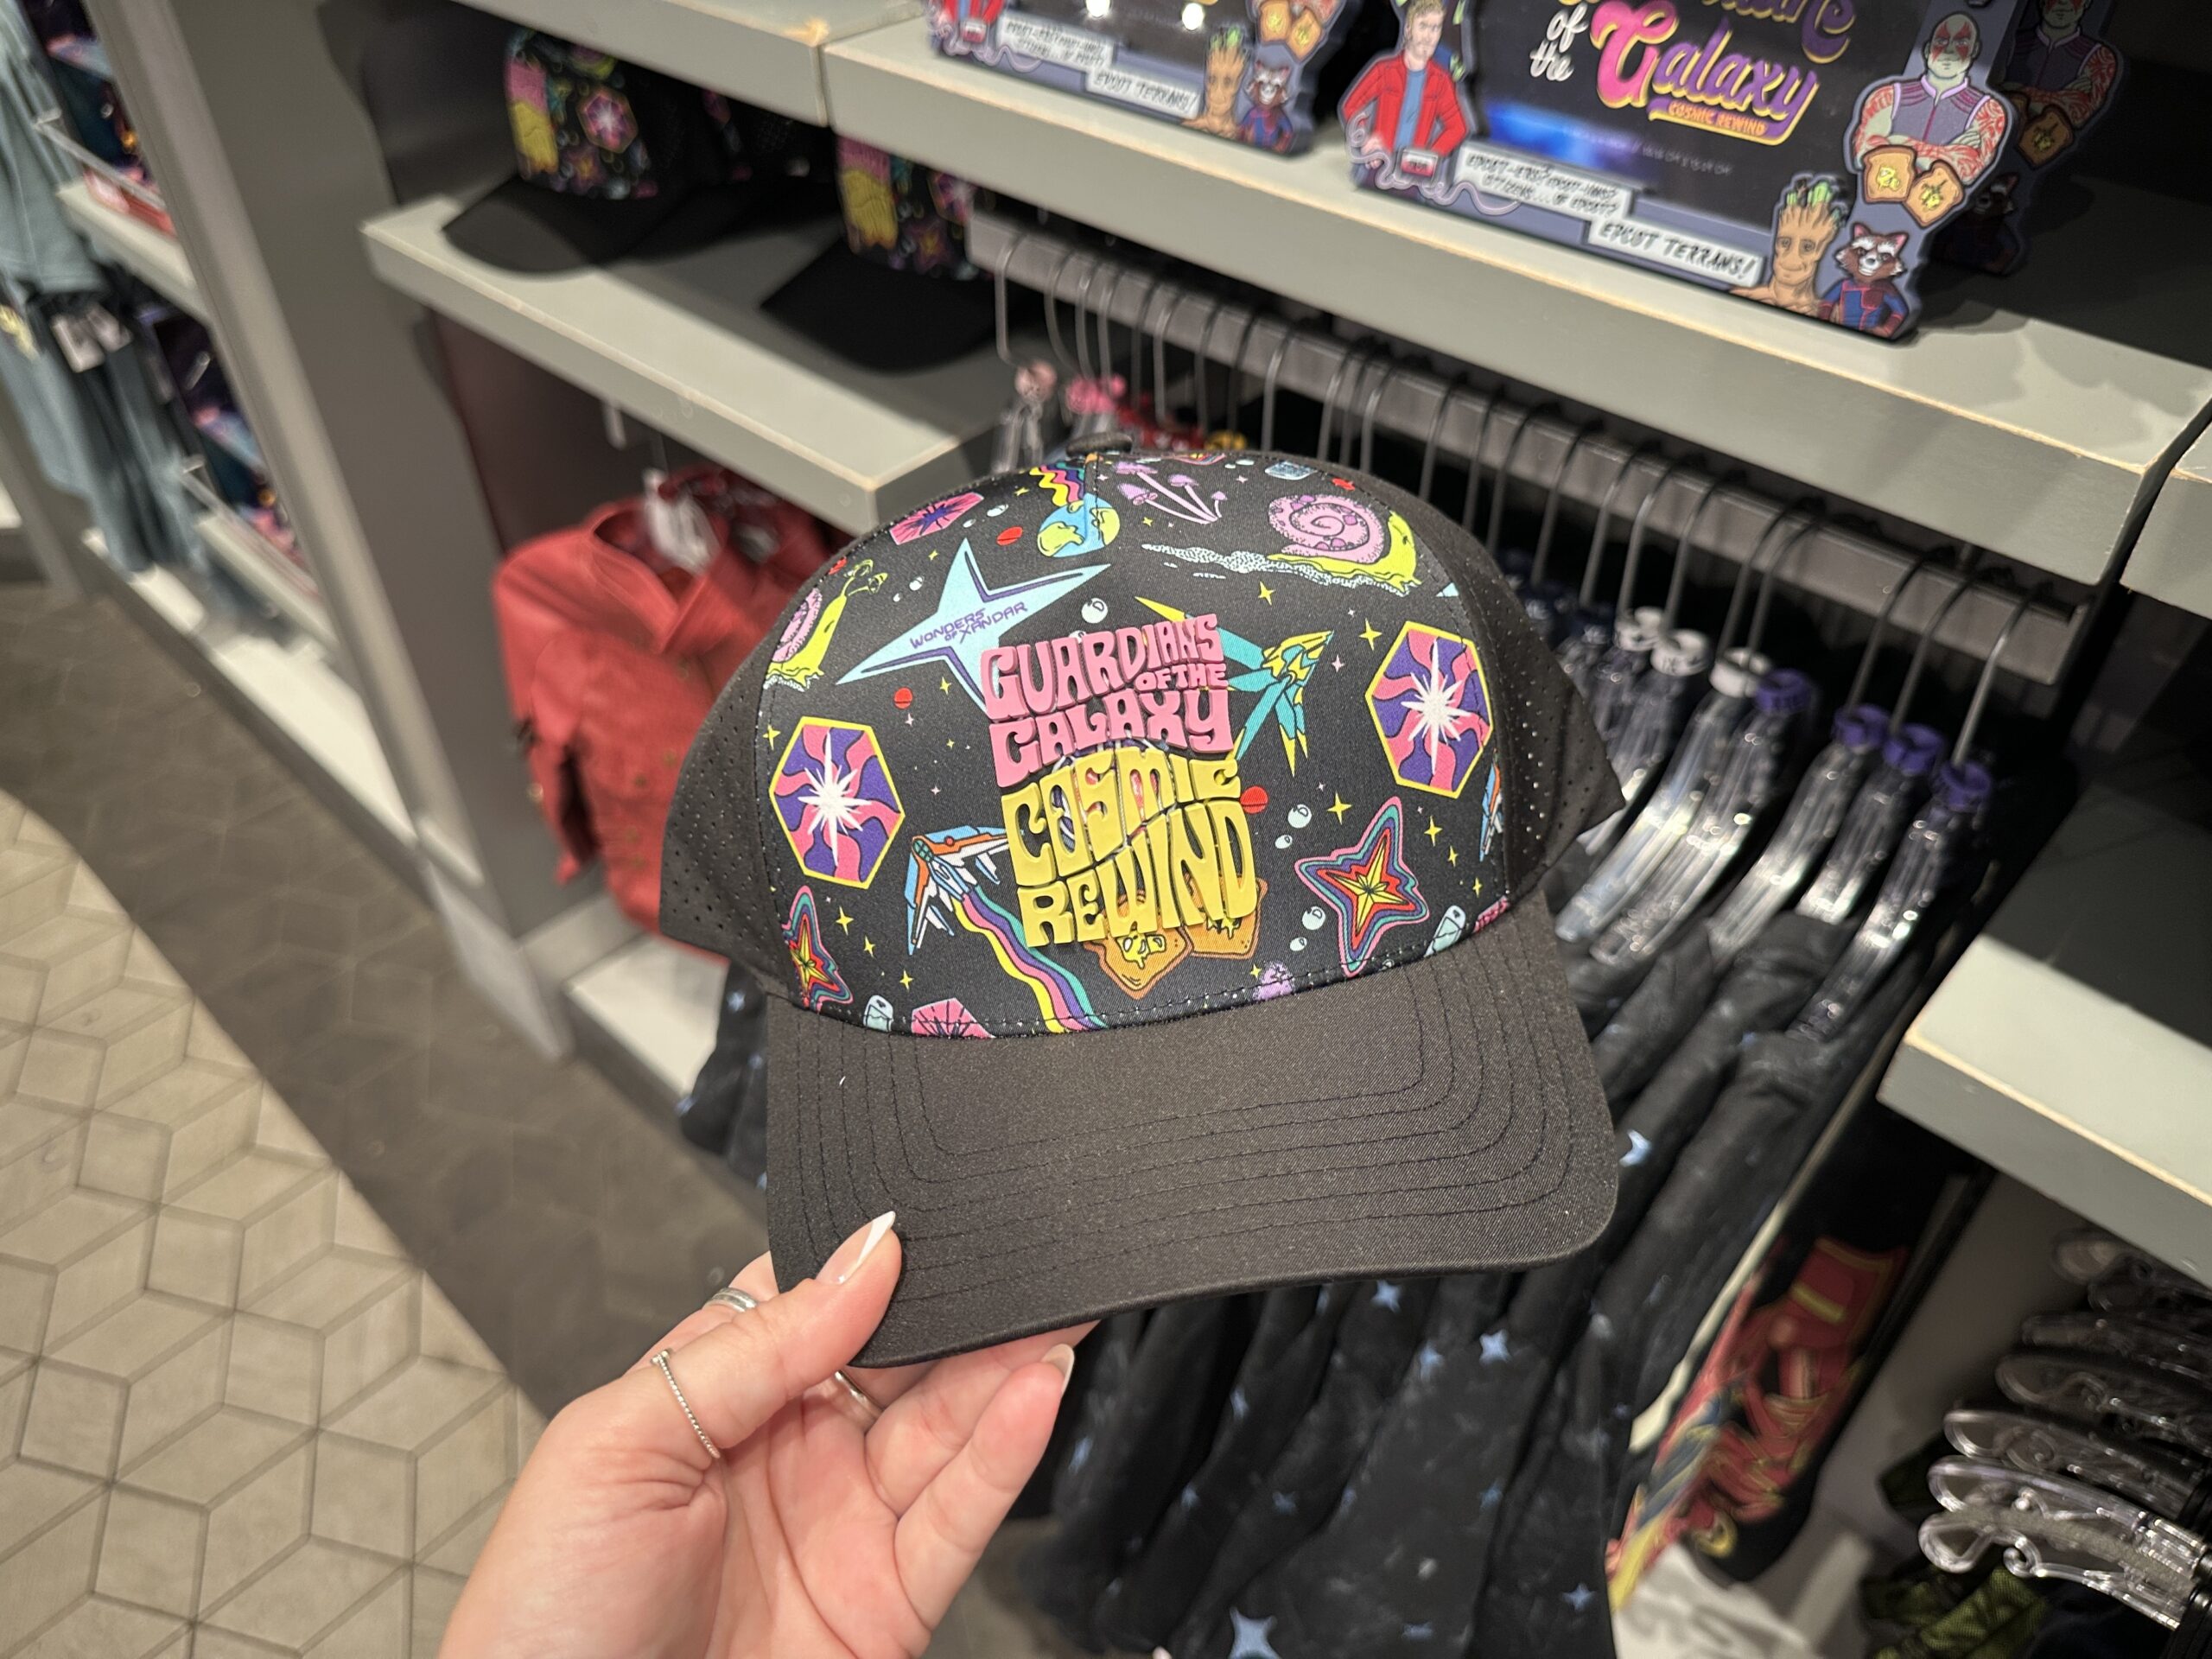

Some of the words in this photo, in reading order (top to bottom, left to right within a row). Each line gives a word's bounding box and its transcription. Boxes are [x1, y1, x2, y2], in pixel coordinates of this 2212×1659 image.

[1546, 3, 1589, 53] of
[1529, 39, 1574, 81] the
[1590, 0, 1819, 122] Galaxy
[1668, 99, 1715, 127] COSMIC
[1716, 109, 1769, 137] REWIND
[1599, 220, 1659, 251] EPCOT
[1663, 237, 1757, 280] TERRANS!
[910, 607, 986, 649] WONDERS
[944, 631, 957, 641] OF
[959, 601, 1028, 645] XANDAR
[980, 613, 1223, 721] GUARDIANS
[1135, 667, 1171, 691] OF
[1171, 663, 1228, 690] THE
[988, 689, 1233, 787] GALAXY
[1001, 747, 1241, 886] COSMIC
[1017, 800, 1258, 948] REWIND
